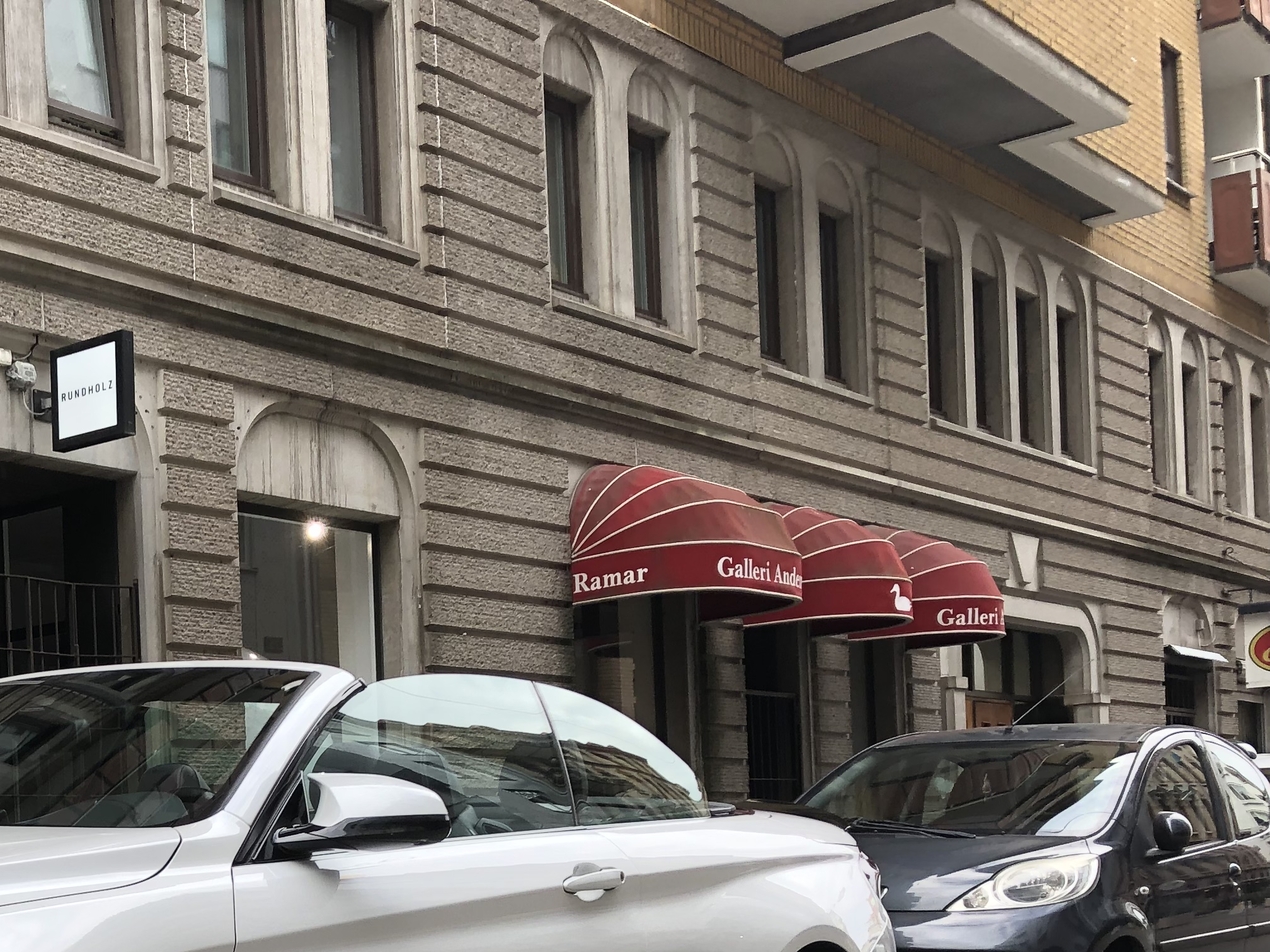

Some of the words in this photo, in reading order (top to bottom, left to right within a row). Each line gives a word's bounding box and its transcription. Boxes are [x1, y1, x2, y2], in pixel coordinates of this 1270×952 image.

[61, 380, 113, 402] RUNDHOLZ
[573, 567, 648, 594] Ramar
[717, 556, 771, 582] Galleri
[936, 607, 998, 626] Galleri
